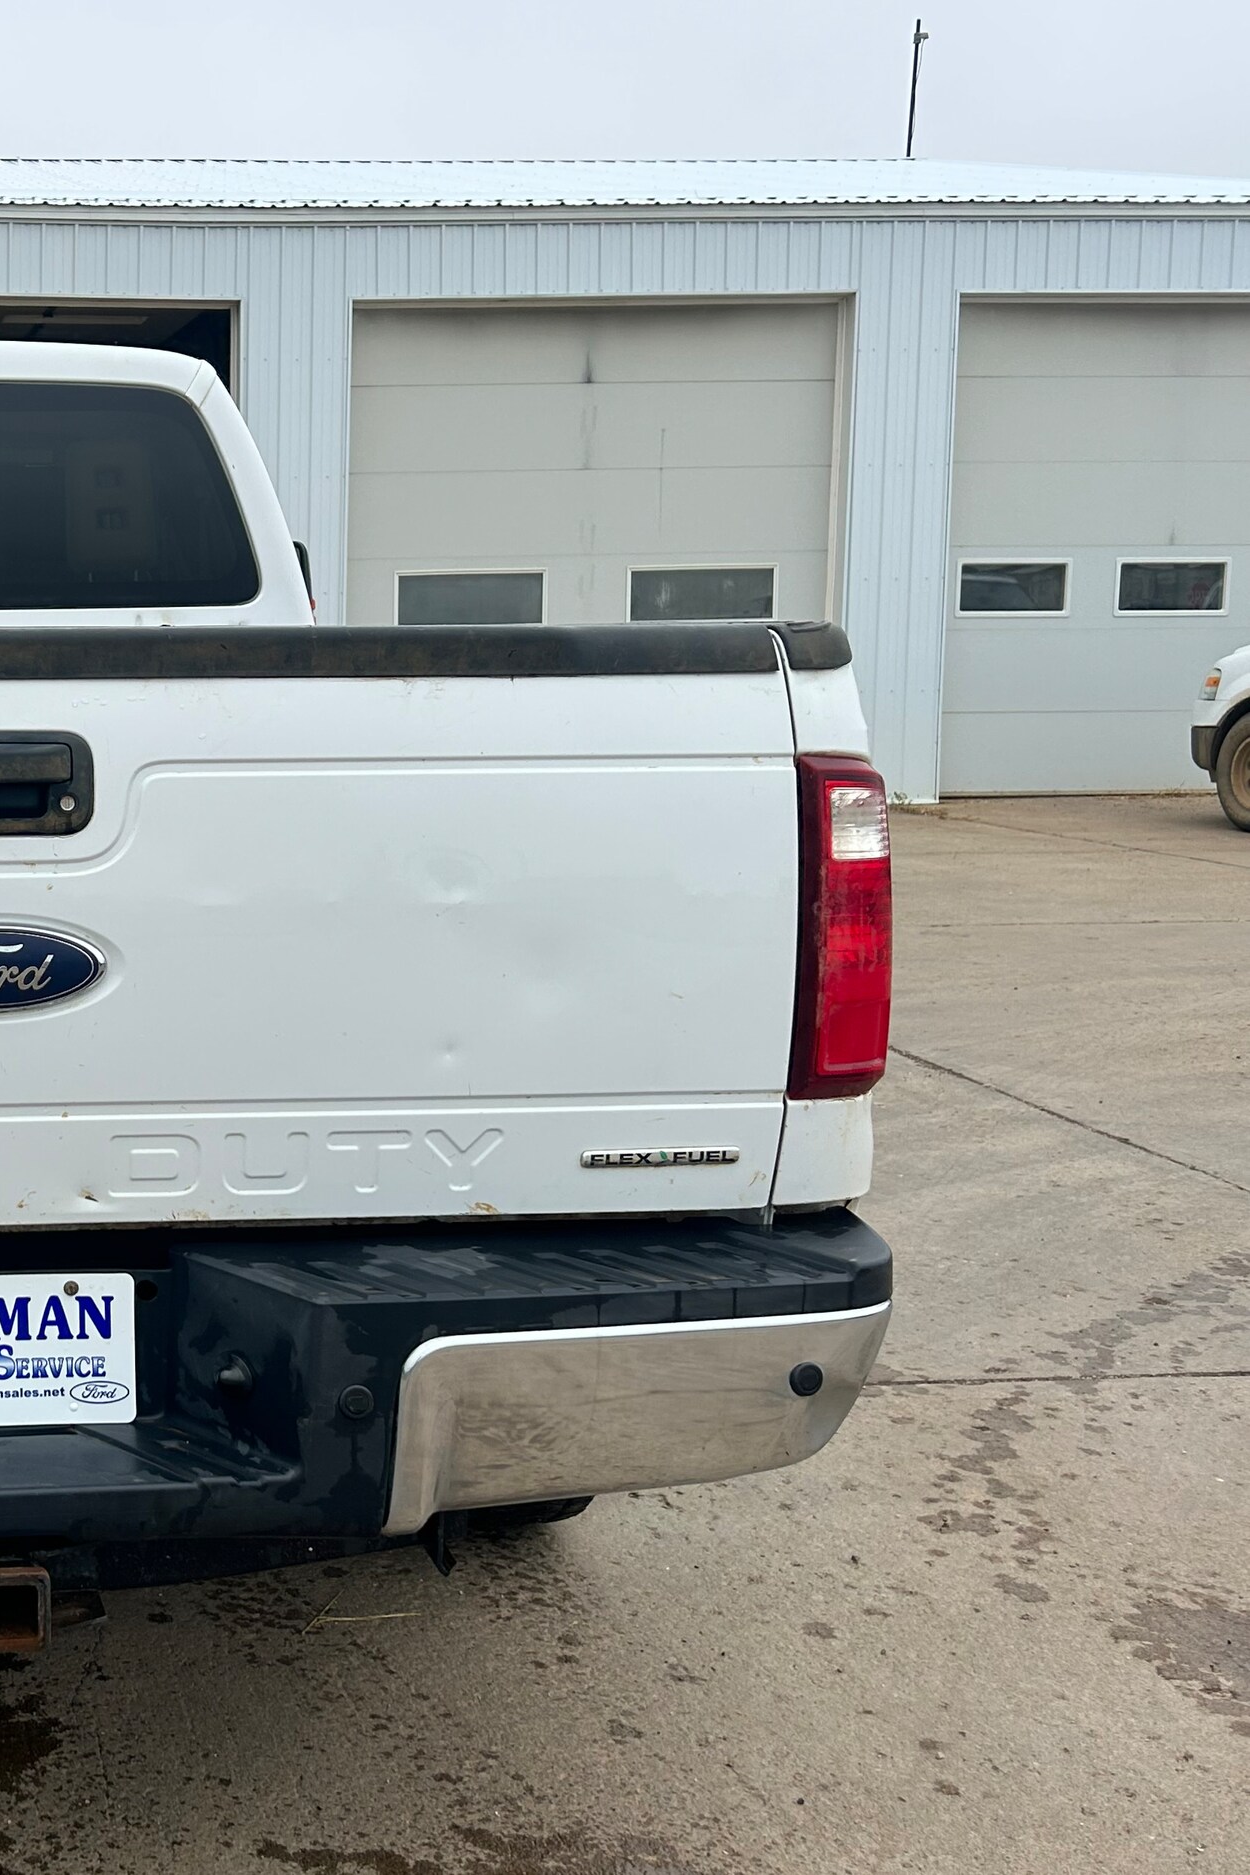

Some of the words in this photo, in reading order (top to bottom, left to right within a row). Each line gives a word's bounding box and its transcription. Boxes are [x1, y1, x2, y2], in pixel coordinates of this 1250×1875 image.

[108, 1128, 505, 1198] DUTY
[590, 1153, 653, 1166] FLEX
[672, 1150, 736, 1163] FUEL
[81, 1383, 118, 1399] Ford
